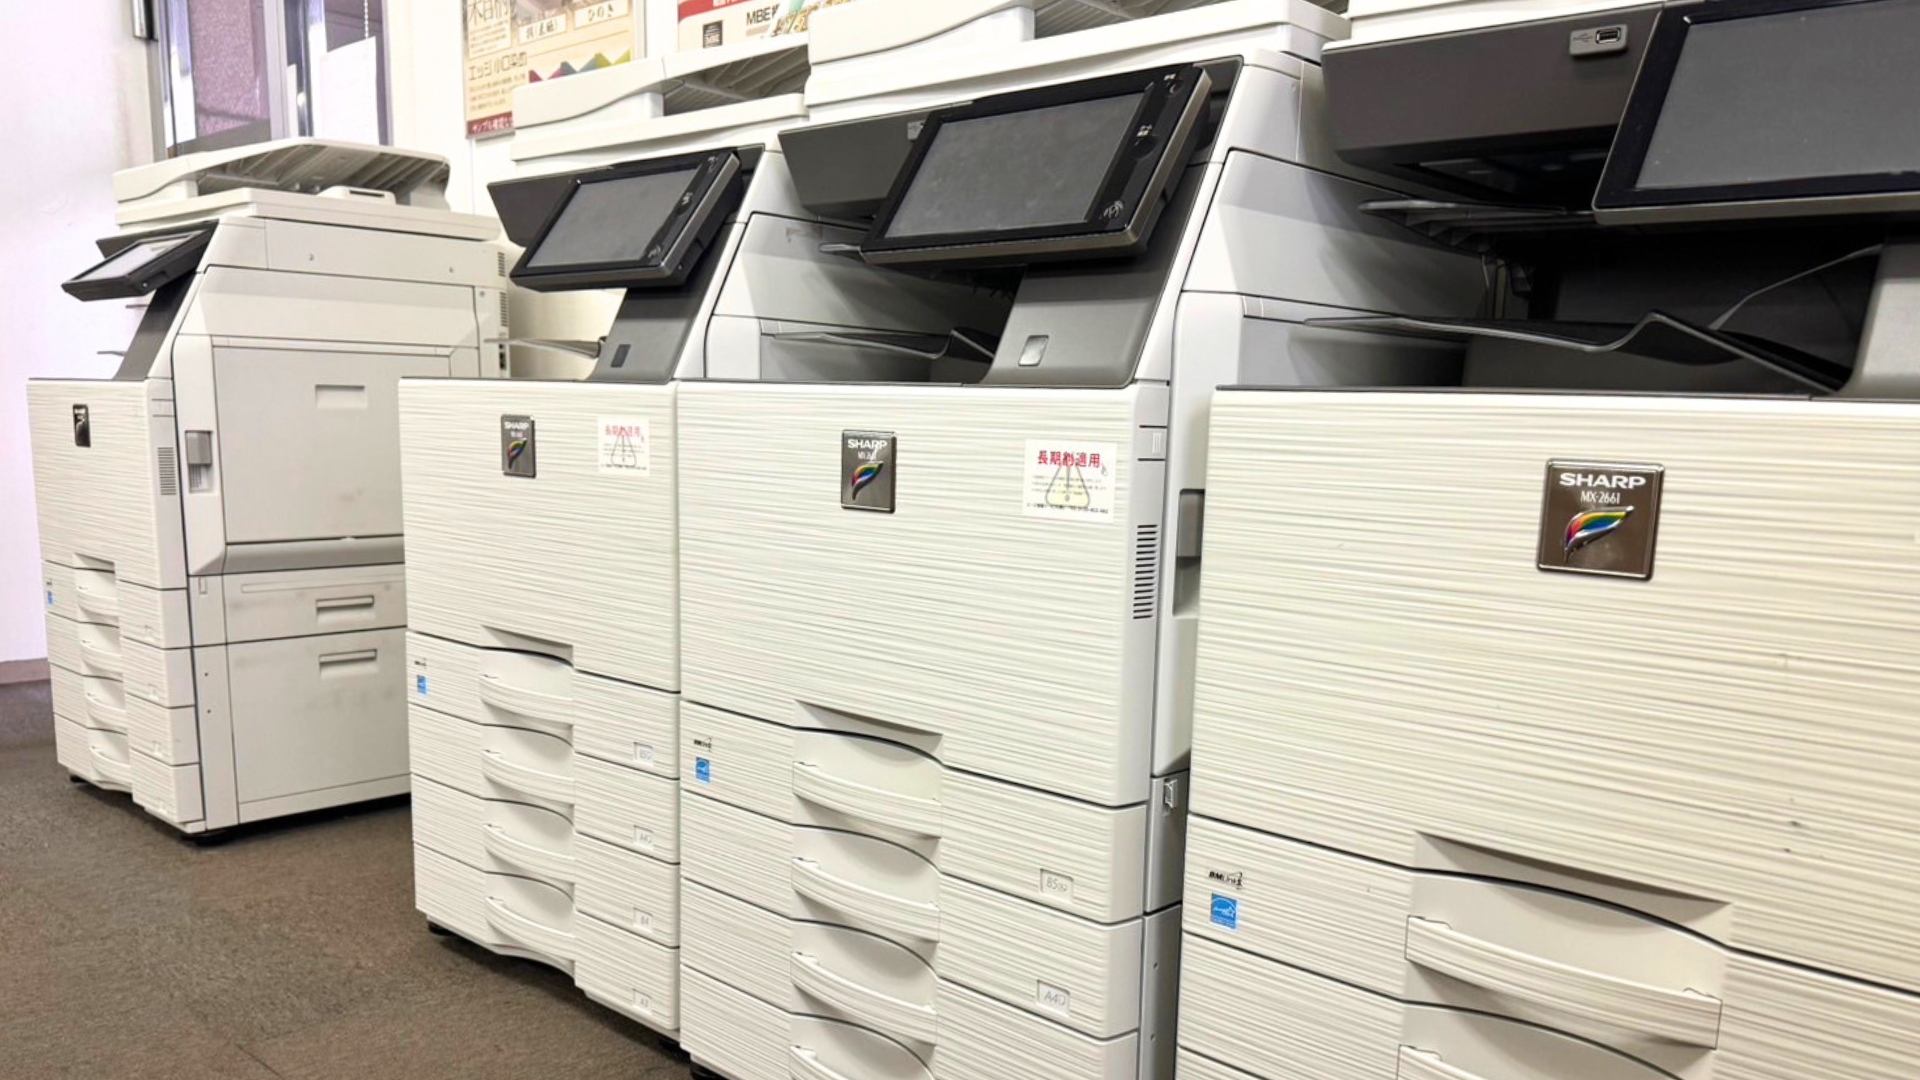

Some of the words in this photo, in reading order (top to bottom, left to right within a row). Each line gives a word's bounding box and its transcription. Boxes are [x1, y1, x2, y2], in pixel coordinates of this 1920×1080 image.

[504, 421, 530, 430] SHARP
[847, 438, 888, 450] SHARP
[1037, 450, 1101, 468] 長期割適用
[1559, 472, 1647, 489] SHARP
[1580, 490, 1621, 505] MX-2661
